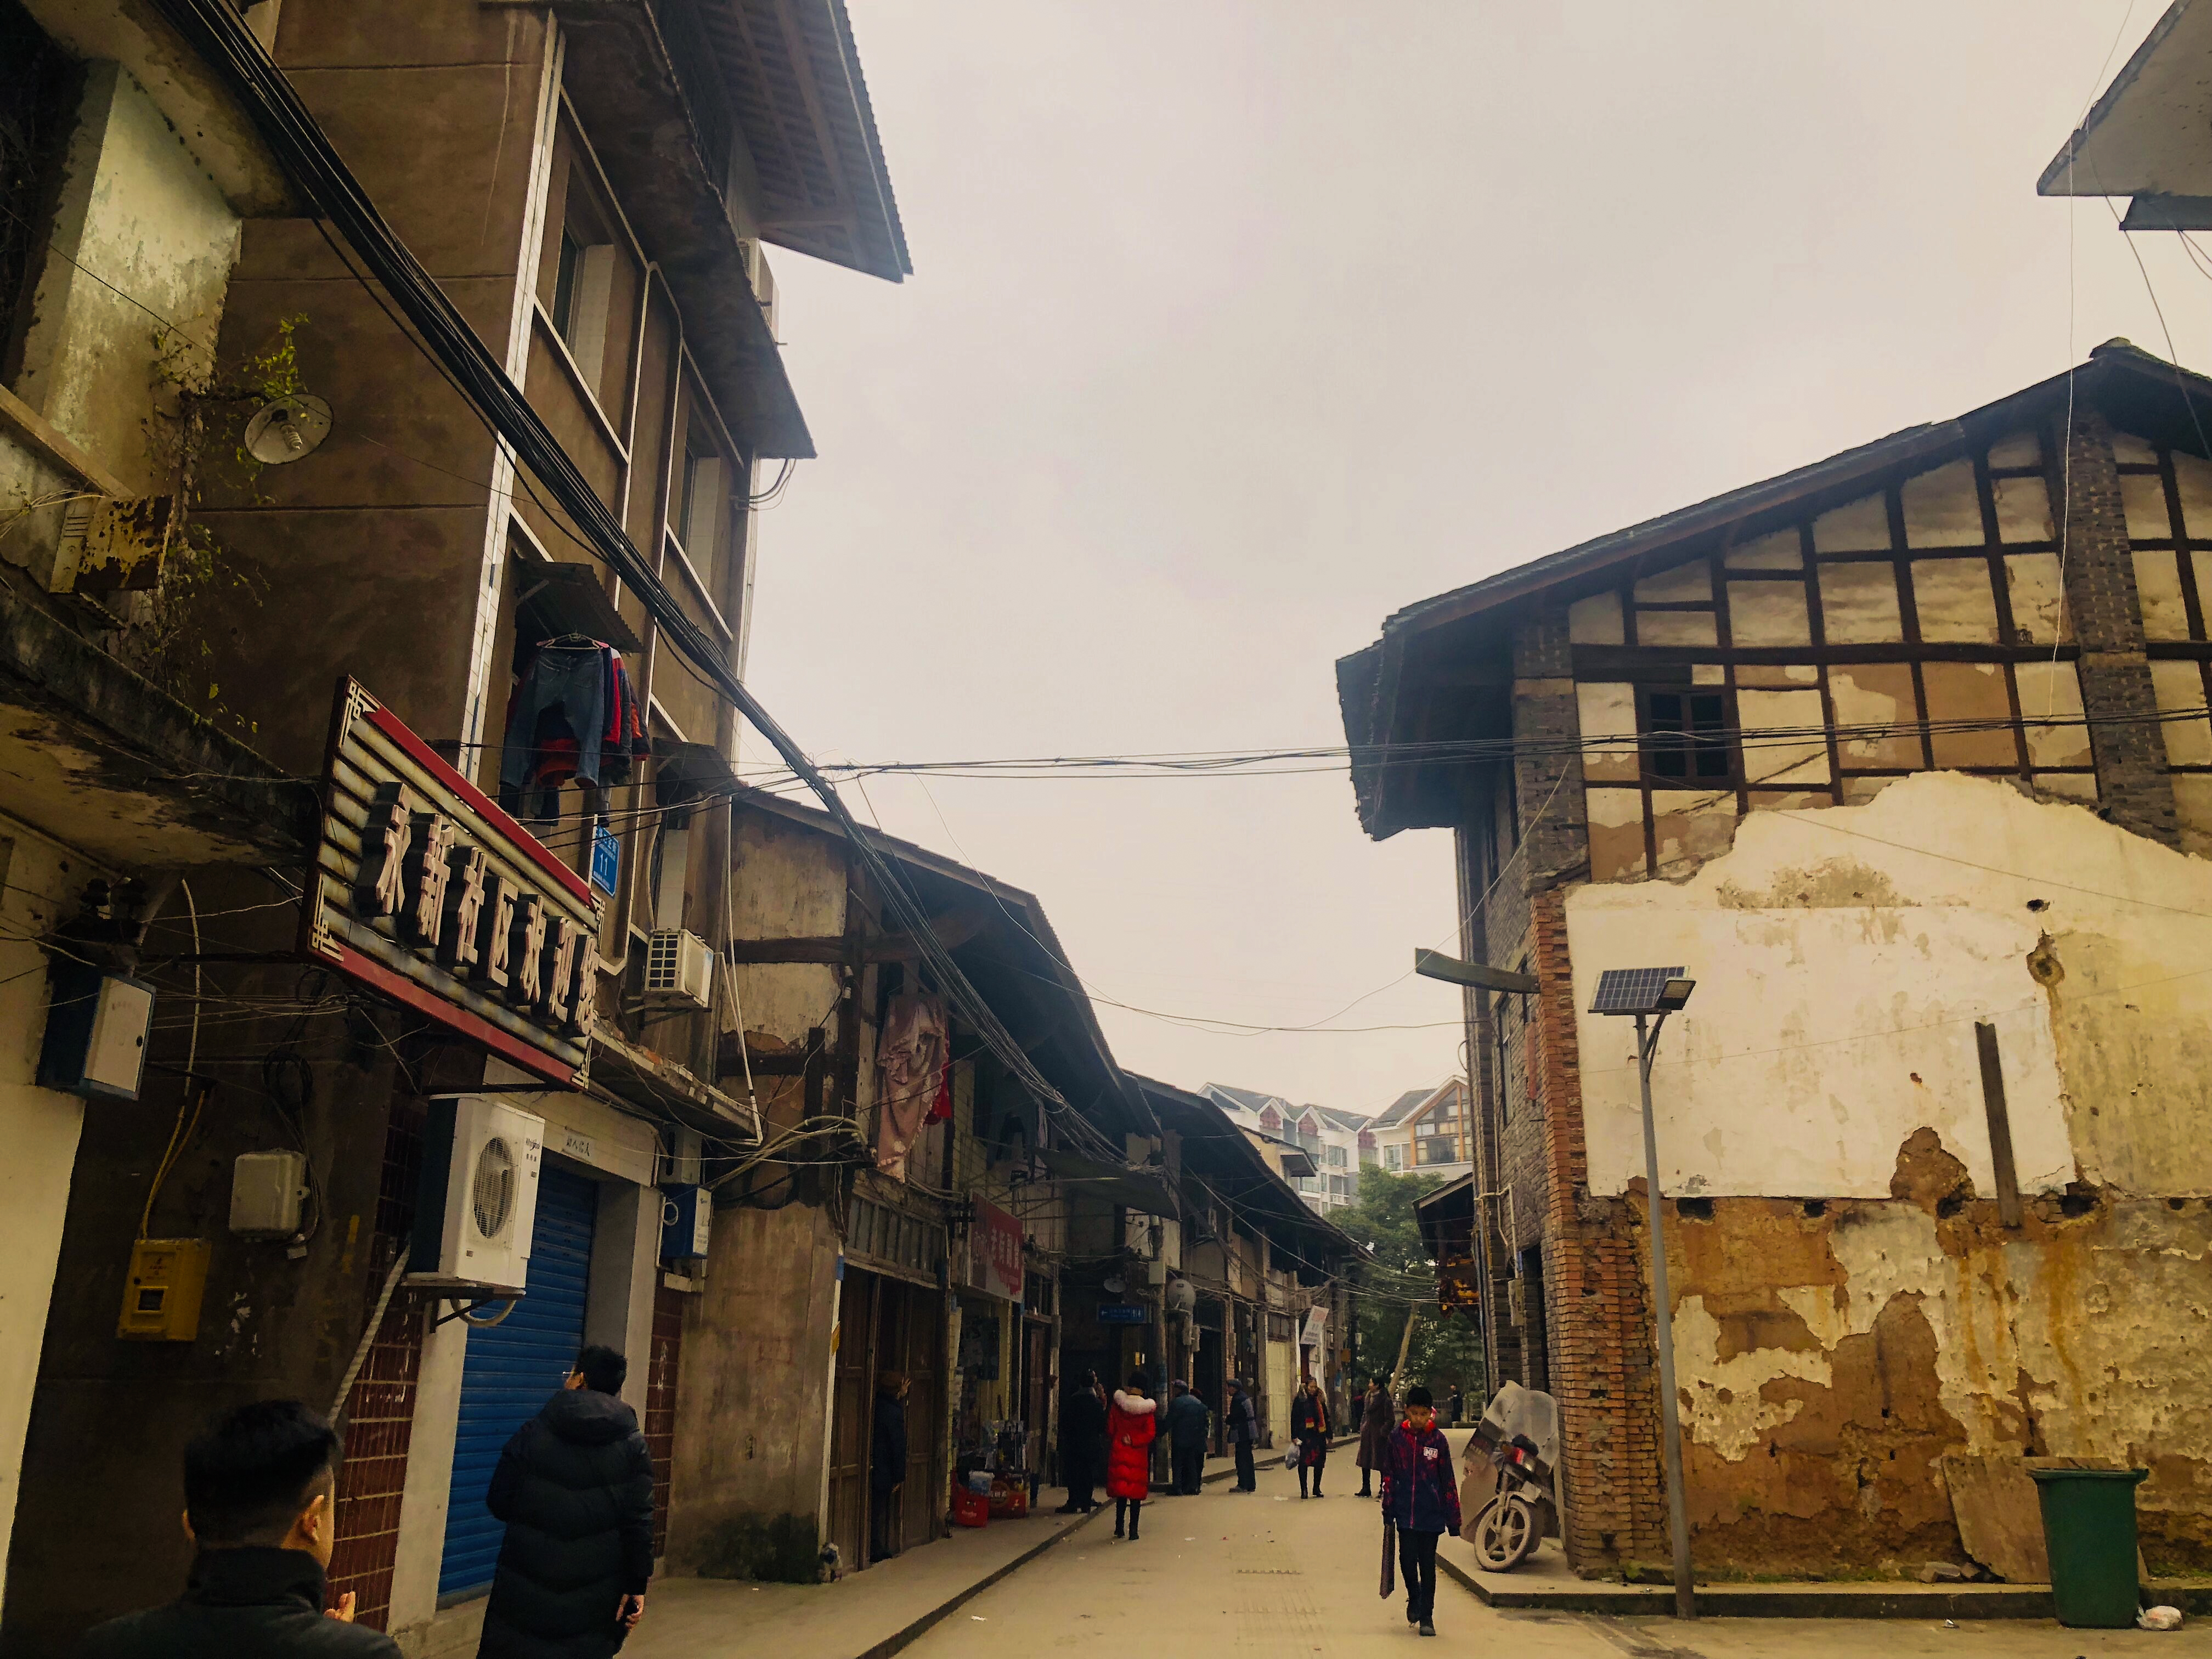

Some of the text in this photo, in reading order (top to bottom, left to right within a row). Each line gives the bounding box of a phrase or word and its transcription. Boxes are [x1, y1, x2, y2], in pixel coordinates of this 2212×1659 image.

[375, 782, 600, 1035] 永新社区欢迎您
[600, 853, 608, 876] 11
